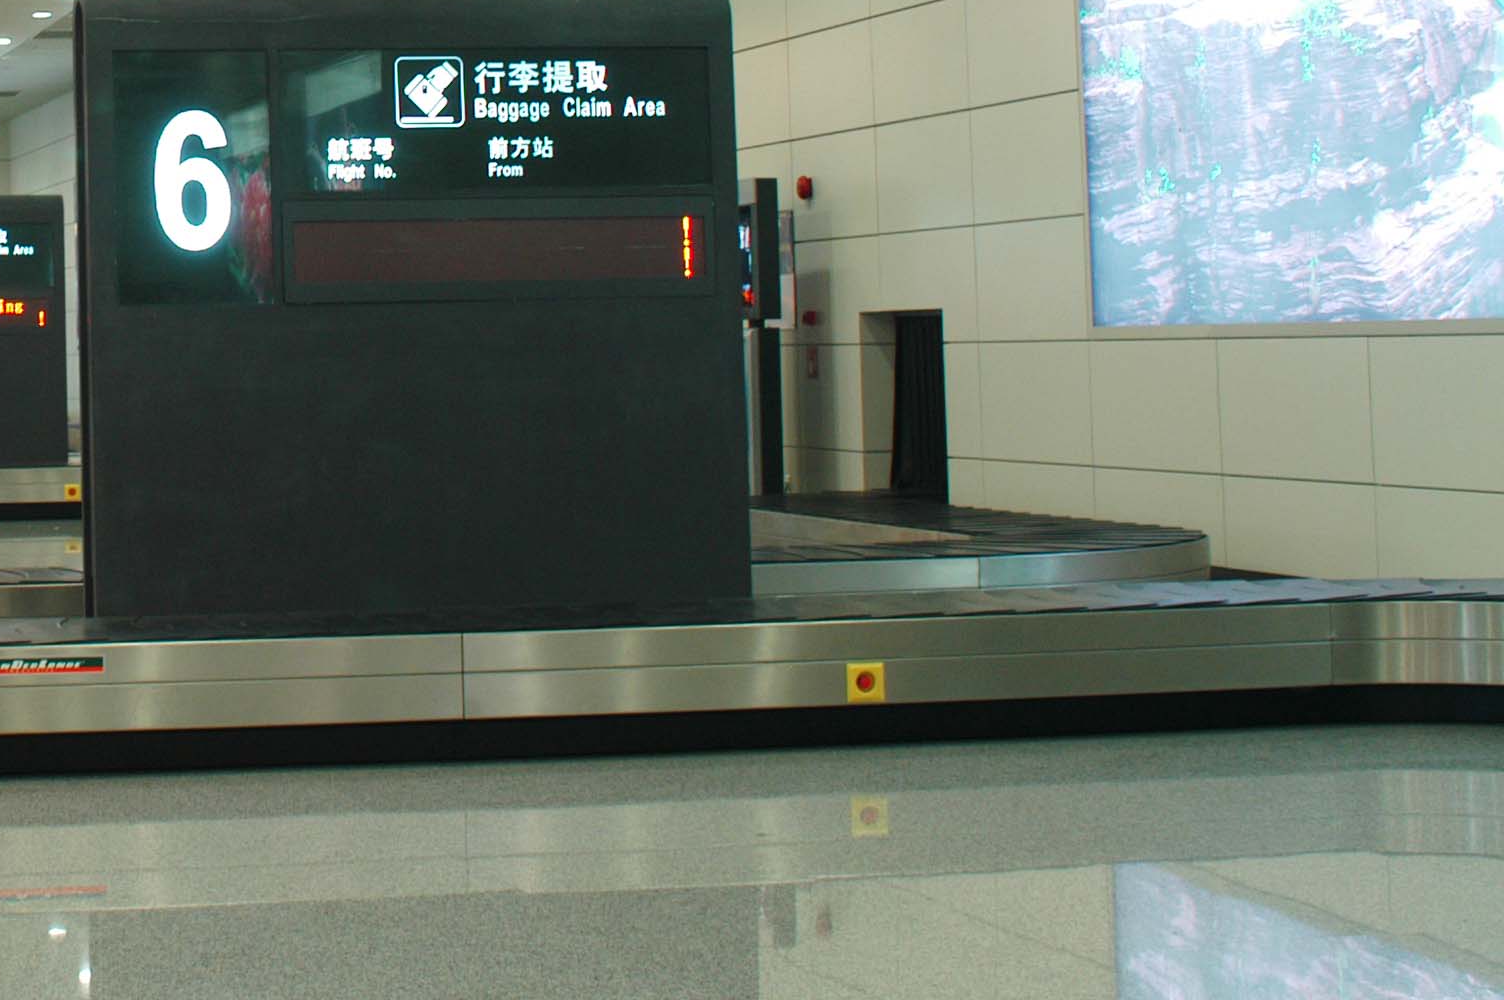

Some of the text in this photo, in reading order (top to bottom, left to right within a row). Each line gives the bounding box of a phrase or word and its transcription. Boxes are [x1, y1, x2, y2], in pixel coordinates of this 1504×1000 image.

[474, 60, 608, 95] 行李提取
[474, 96, 666, 123] Baggage Claim Area
[488, 136, 554, 159] 前方站
[153, 109, 233, 252] 6
[327, 164, 397, 182] Flight No.
[488, 162, 524, 178] From
